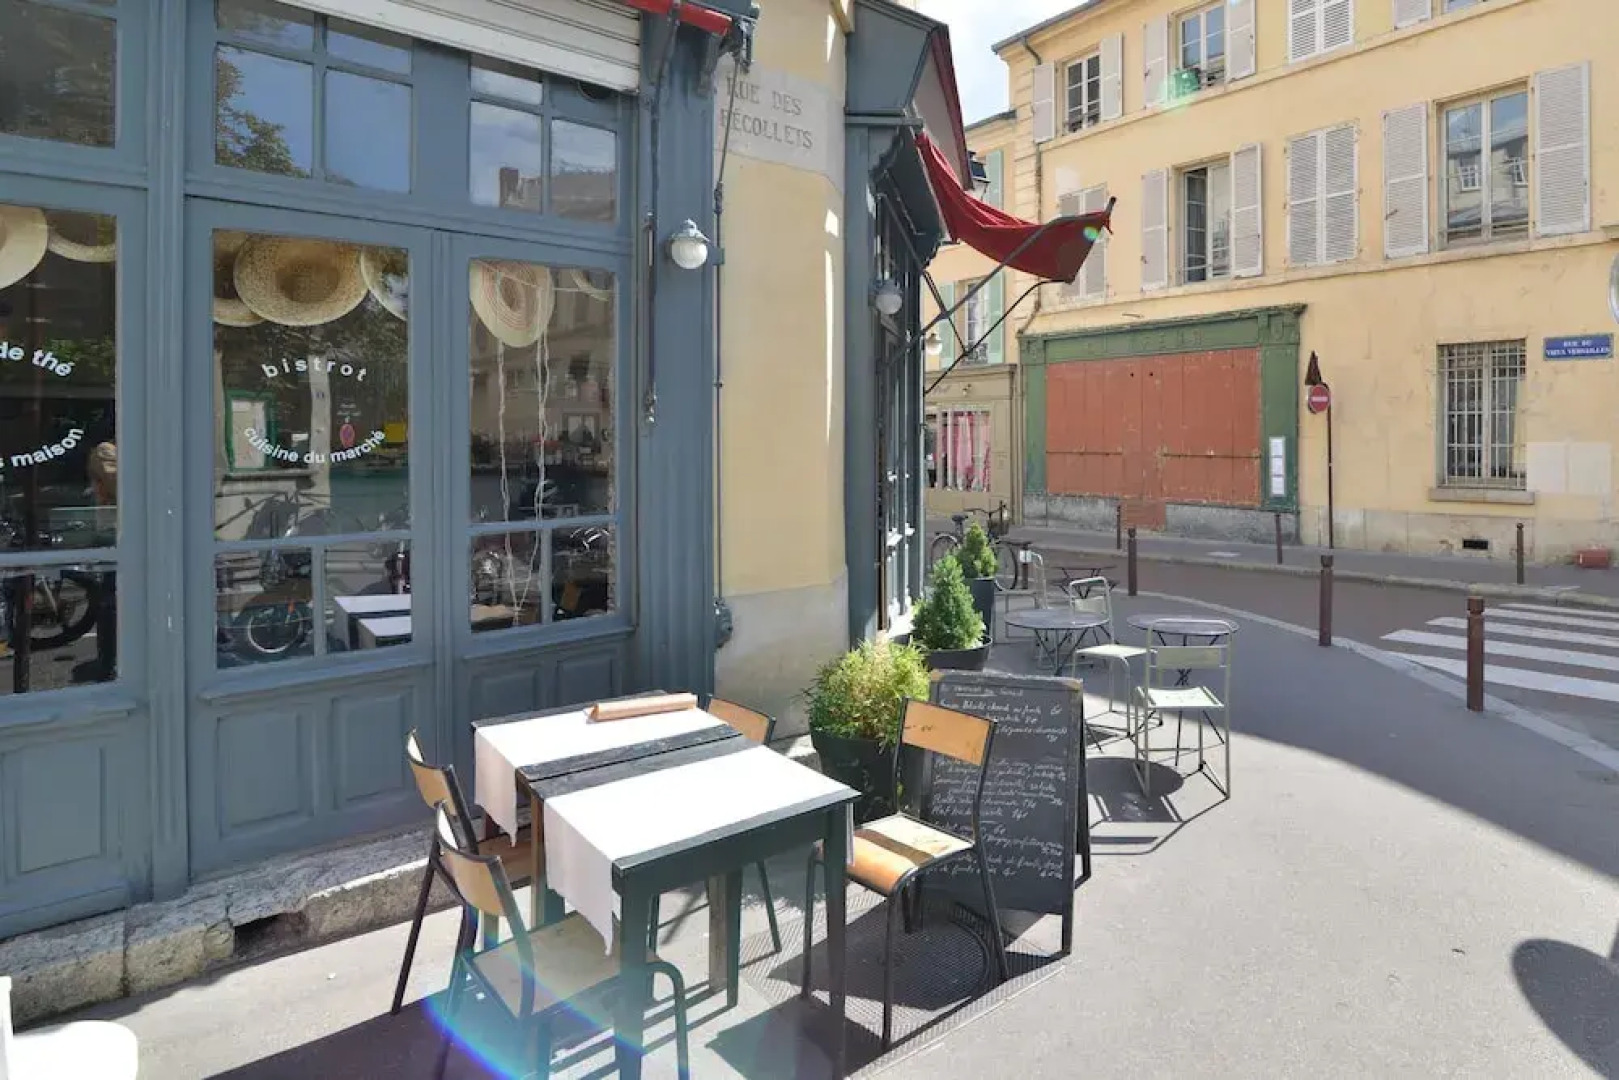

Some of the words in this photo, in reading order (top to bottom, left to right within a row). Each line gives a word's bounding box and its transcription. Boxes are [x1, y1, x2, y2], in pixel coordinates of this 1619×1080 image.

[726, 77, 760, 104] RUE
[772, 90, 802, 115] DES
[32, 349, 76, 377] thé
[261, 357, 367, 382] bistrot
[11, 427, 85, 468] maison
[244, 427, 299, 462] cuisine
[303, 451, 325, 464] du
[330, 429, 386, 462] marché
